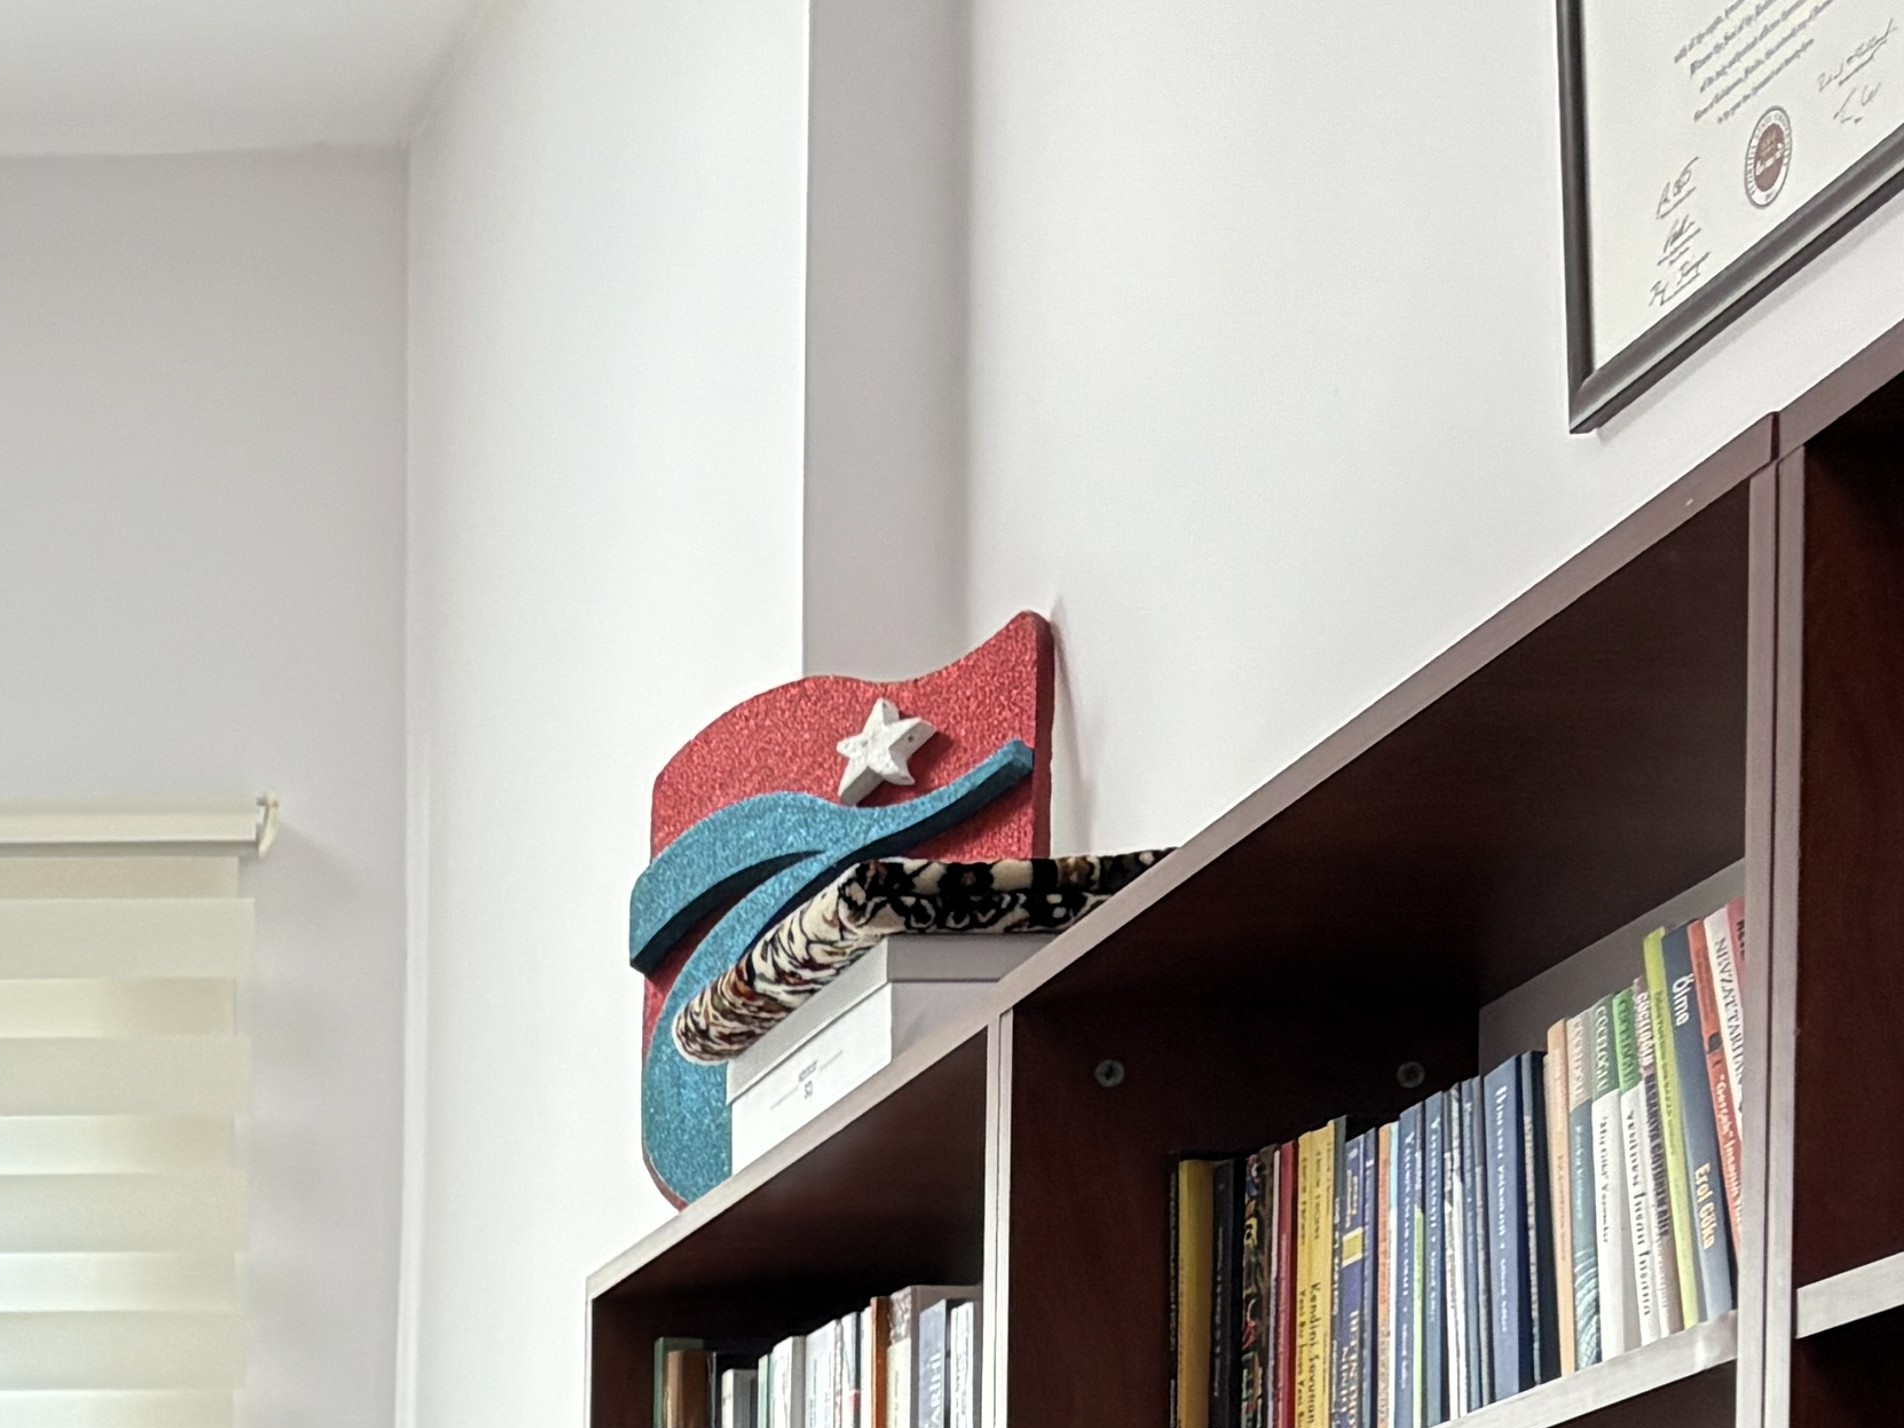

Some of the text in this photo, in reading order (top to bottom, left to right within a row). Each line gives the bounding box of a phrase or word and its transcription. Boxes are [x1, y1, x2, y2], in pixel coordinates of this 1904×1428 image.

[1714, 936, 1737, 1013] NEVZAT
[1693, 1161, 1712, 1203] Erol
[1698, 1200, 1718, 1251] Göka
[1309, 1279, 1321, 1348] Kendini
